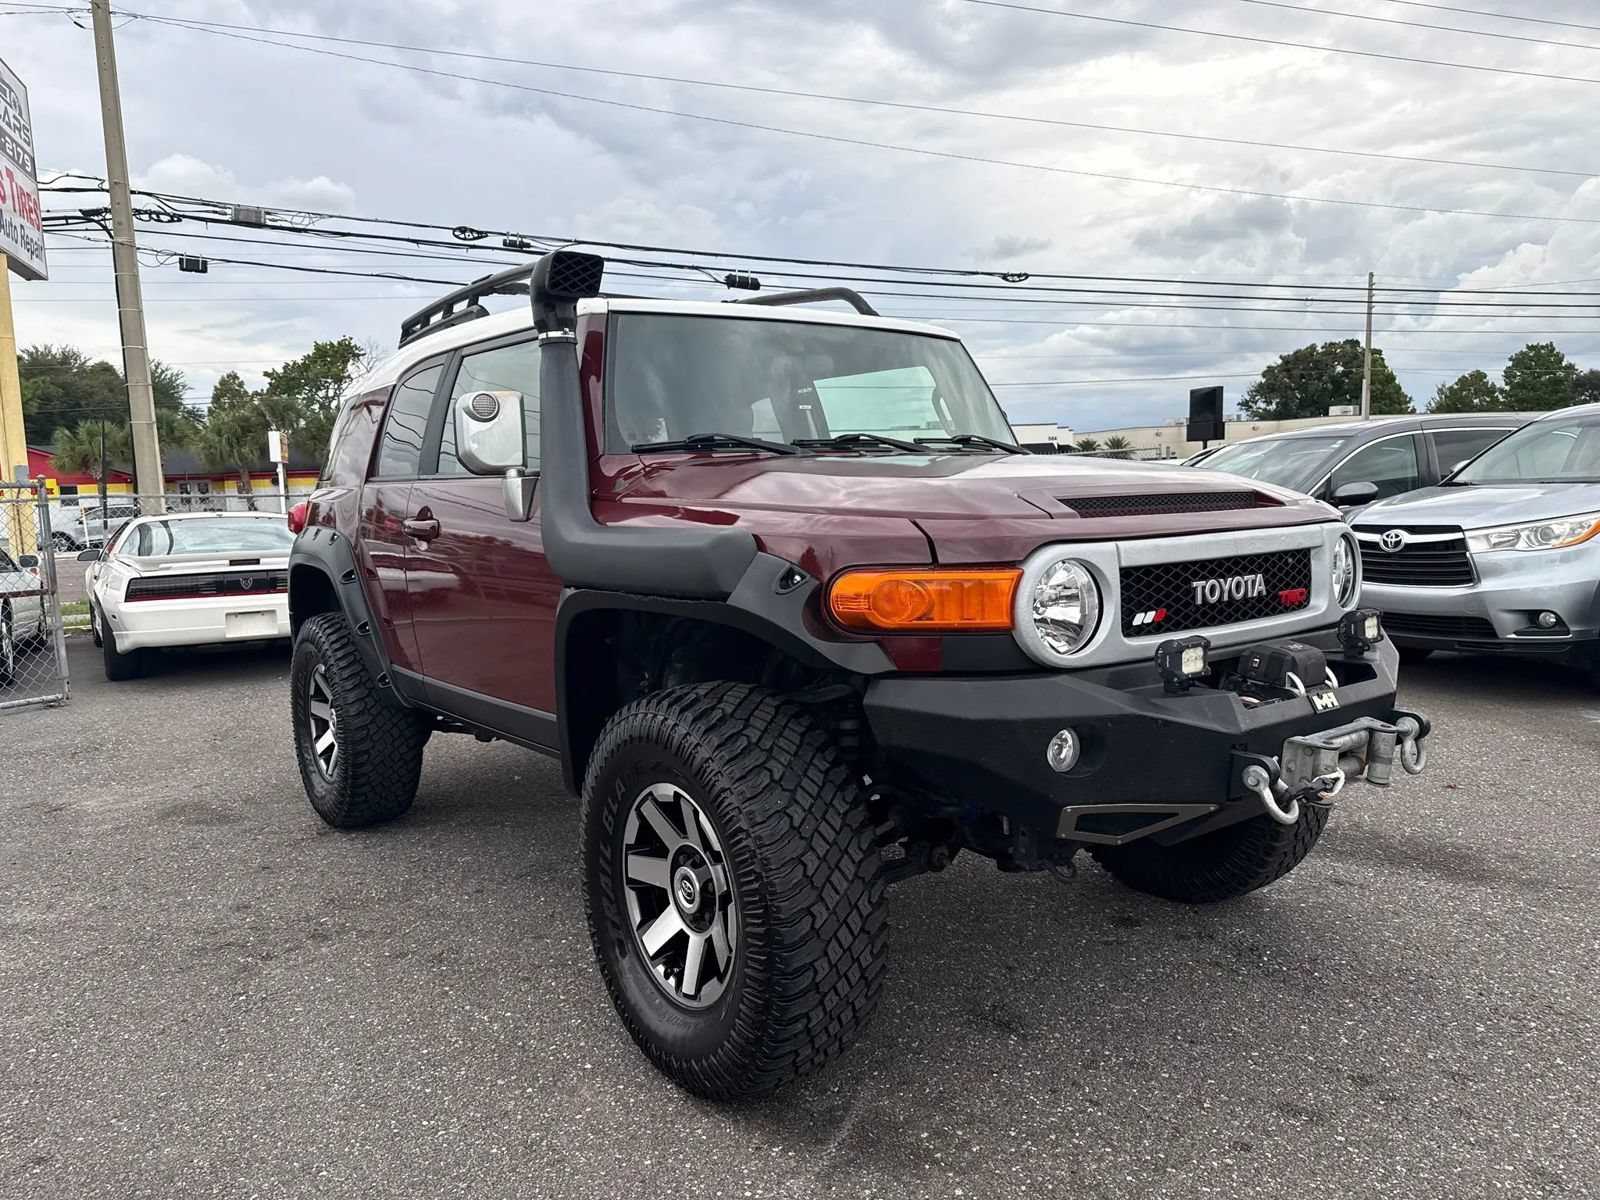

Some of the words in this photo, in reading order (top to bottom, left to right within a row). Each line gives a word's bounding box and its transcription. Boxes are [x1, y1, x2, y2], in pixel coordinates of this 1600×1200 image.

[0, 106, 31, 148] ARS
[20, 224, 43, 262] Repair
[1191, 573, 1267, 605] TOYOTA
